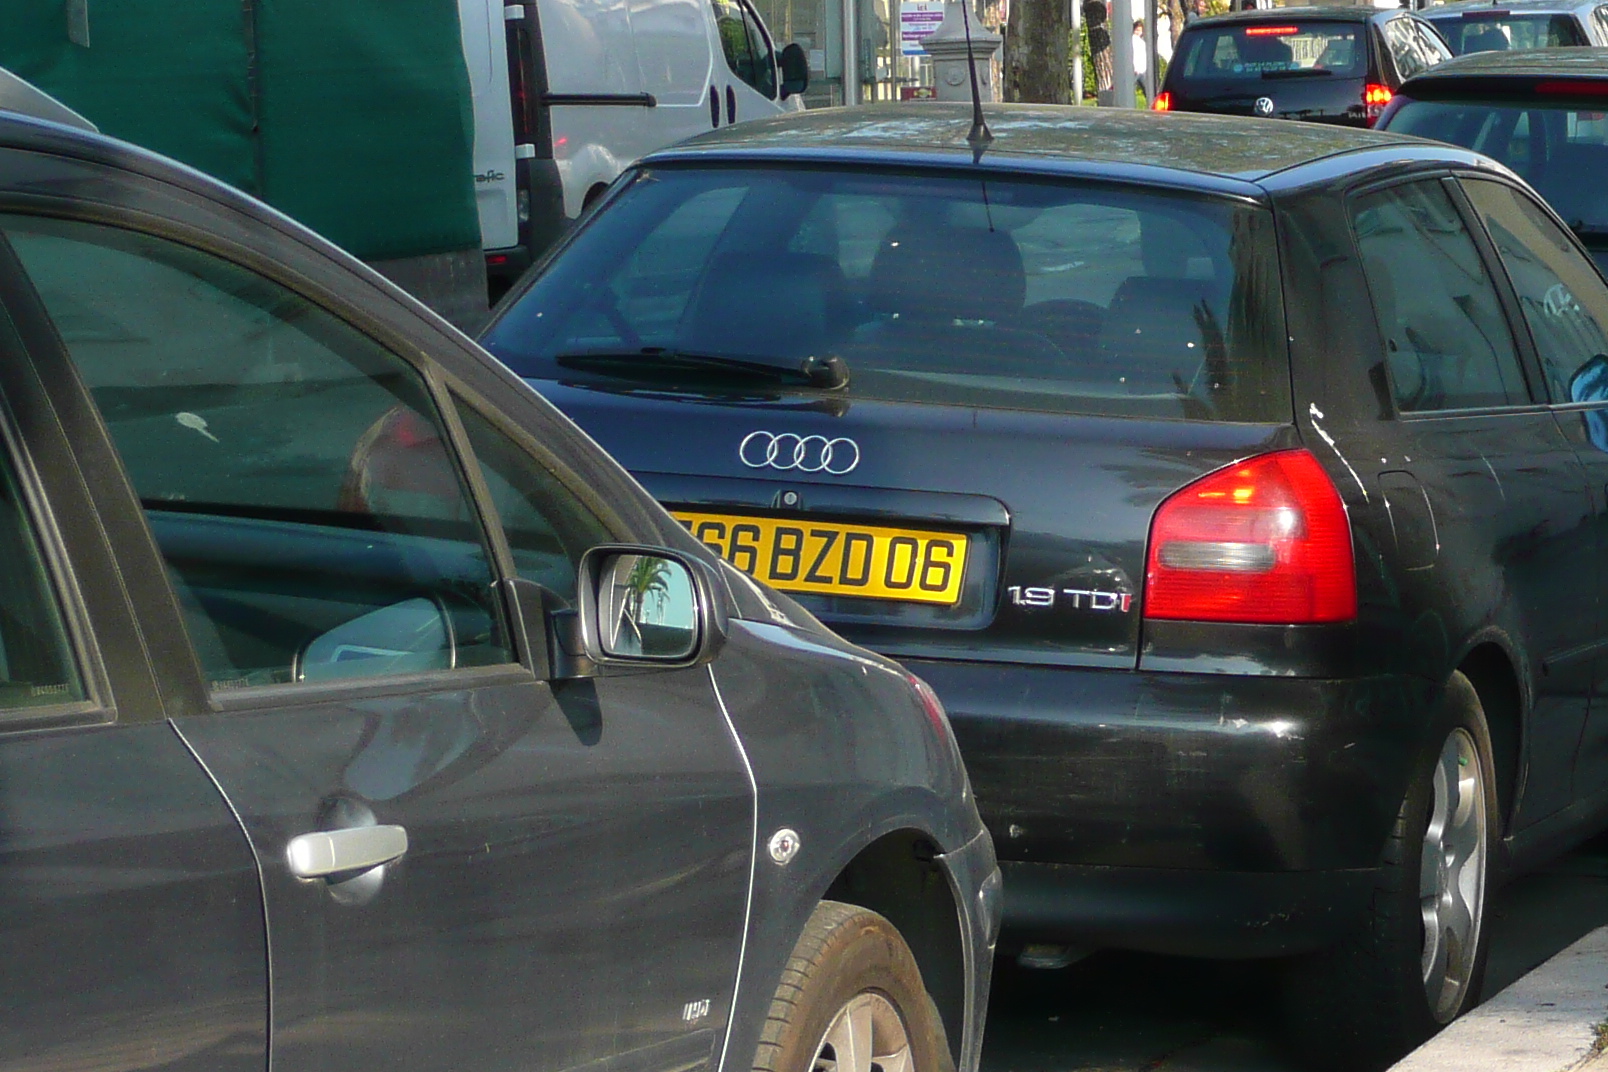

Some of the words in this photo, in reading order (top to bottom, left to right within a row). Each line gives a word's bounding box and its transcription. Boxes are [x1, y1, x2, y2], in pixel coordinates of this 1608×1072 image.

[678, 520, 761, 577] 66
[768, 526, 874, 588] BZD
[883, 536, 955, 593] 06
[1007, 586, 1056, 606] 1.9
